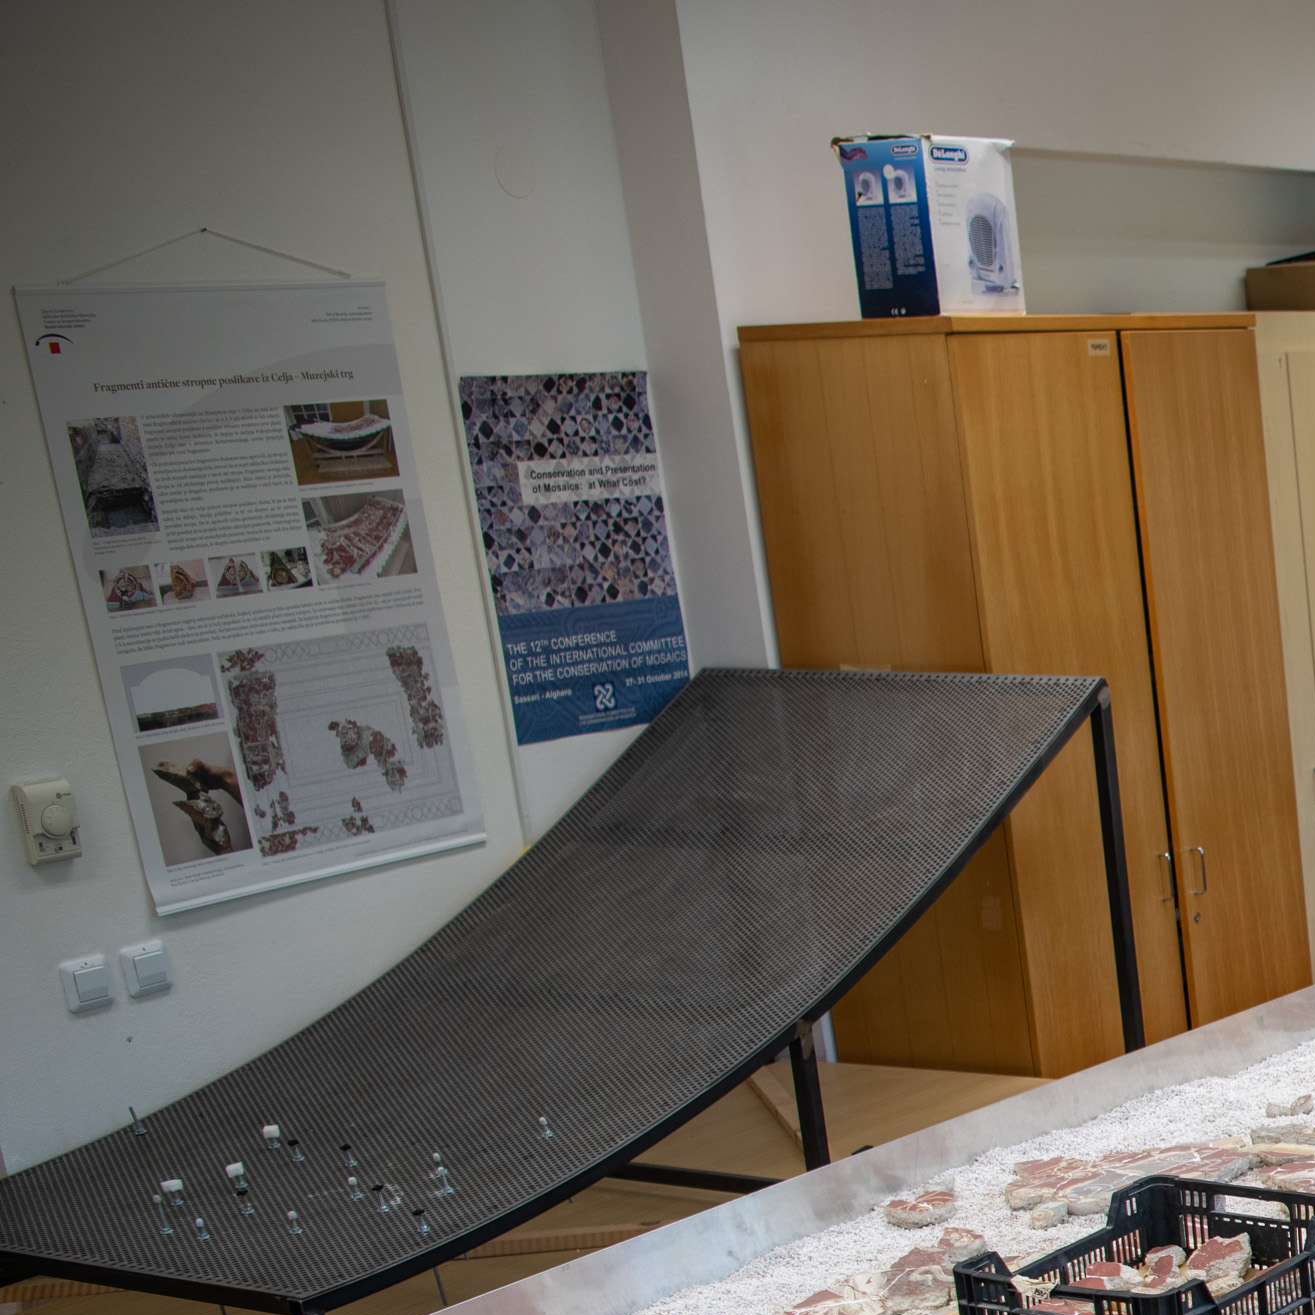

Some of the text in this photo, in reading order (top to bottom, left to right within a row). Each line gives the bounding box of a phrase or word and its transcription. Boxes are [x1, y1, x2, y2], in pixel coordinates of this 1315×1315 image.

[93, 380, 145, 393] Fragmenti
[145, 378, 181, 390] antične
[181, 377, 217, 389] stropne
[218, 373, 260, 388] poslikave
[261, 373, 270, 383] iz
[271, 370, 294, 383] Celja
[300, 369, 339, 382] Muzejski
[340, 369, 354, 380] trg
[530, 462, 656, 480] Conservation and Presentation
[532, 477, 646, 494] of Mosaics: at What Cost?
[507, 642, 528, 656] THE
[551, 630, 617, 650] CONFERENCE
[509, 635, 685, 671] OF THE INTERNATIONAL COMMITTEE
[512, 650, 687, 686] FOR THE CONSERVATION OF MOSAICS
[646, 673, 672, 684] October
[673, 670, 688, 680] 2014
[514, 692, 540, 704] Sassari
[545, 688, 572, 700] Alghero
